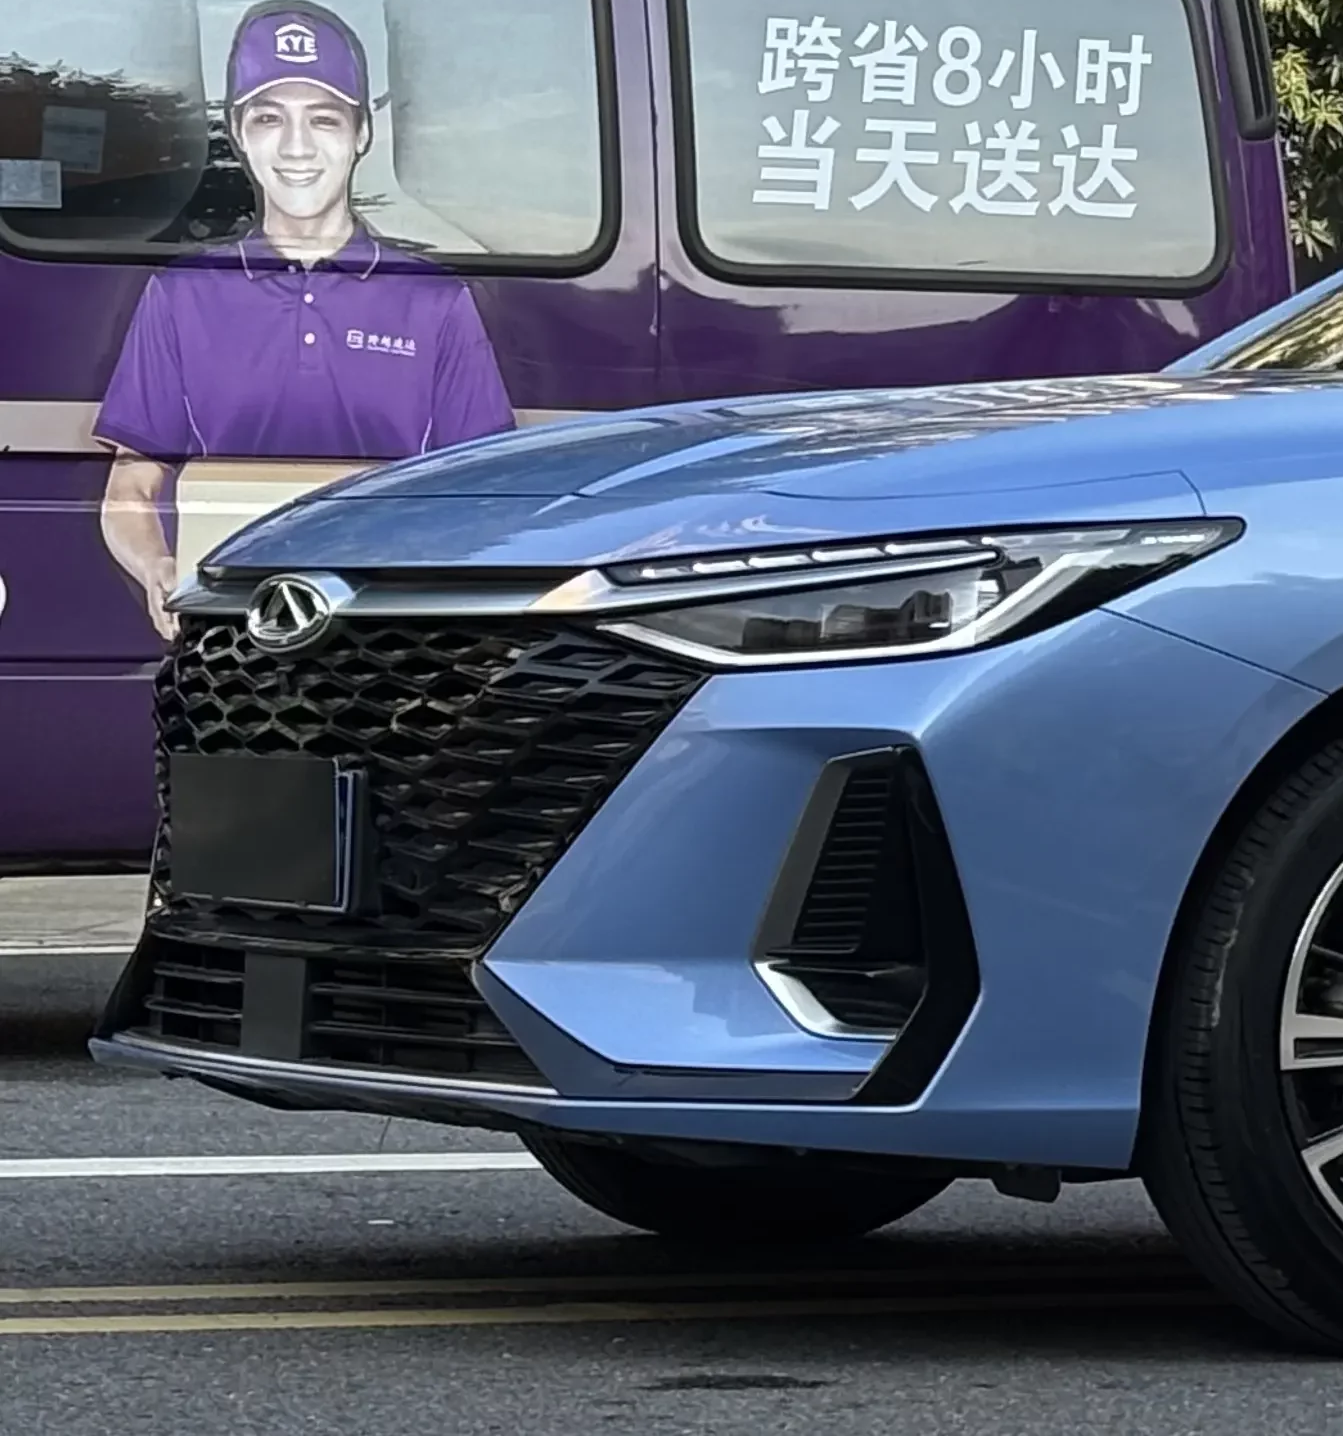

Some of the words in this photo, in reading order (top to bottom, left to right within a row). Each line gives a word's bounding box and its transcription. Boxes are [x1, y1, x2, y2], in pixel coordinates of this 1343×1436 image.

[277, 34, 317, 54] KYE
[757, 16, 1153, 117] 跨省8小时
[752, 109, 1139, 219] 当天送达
